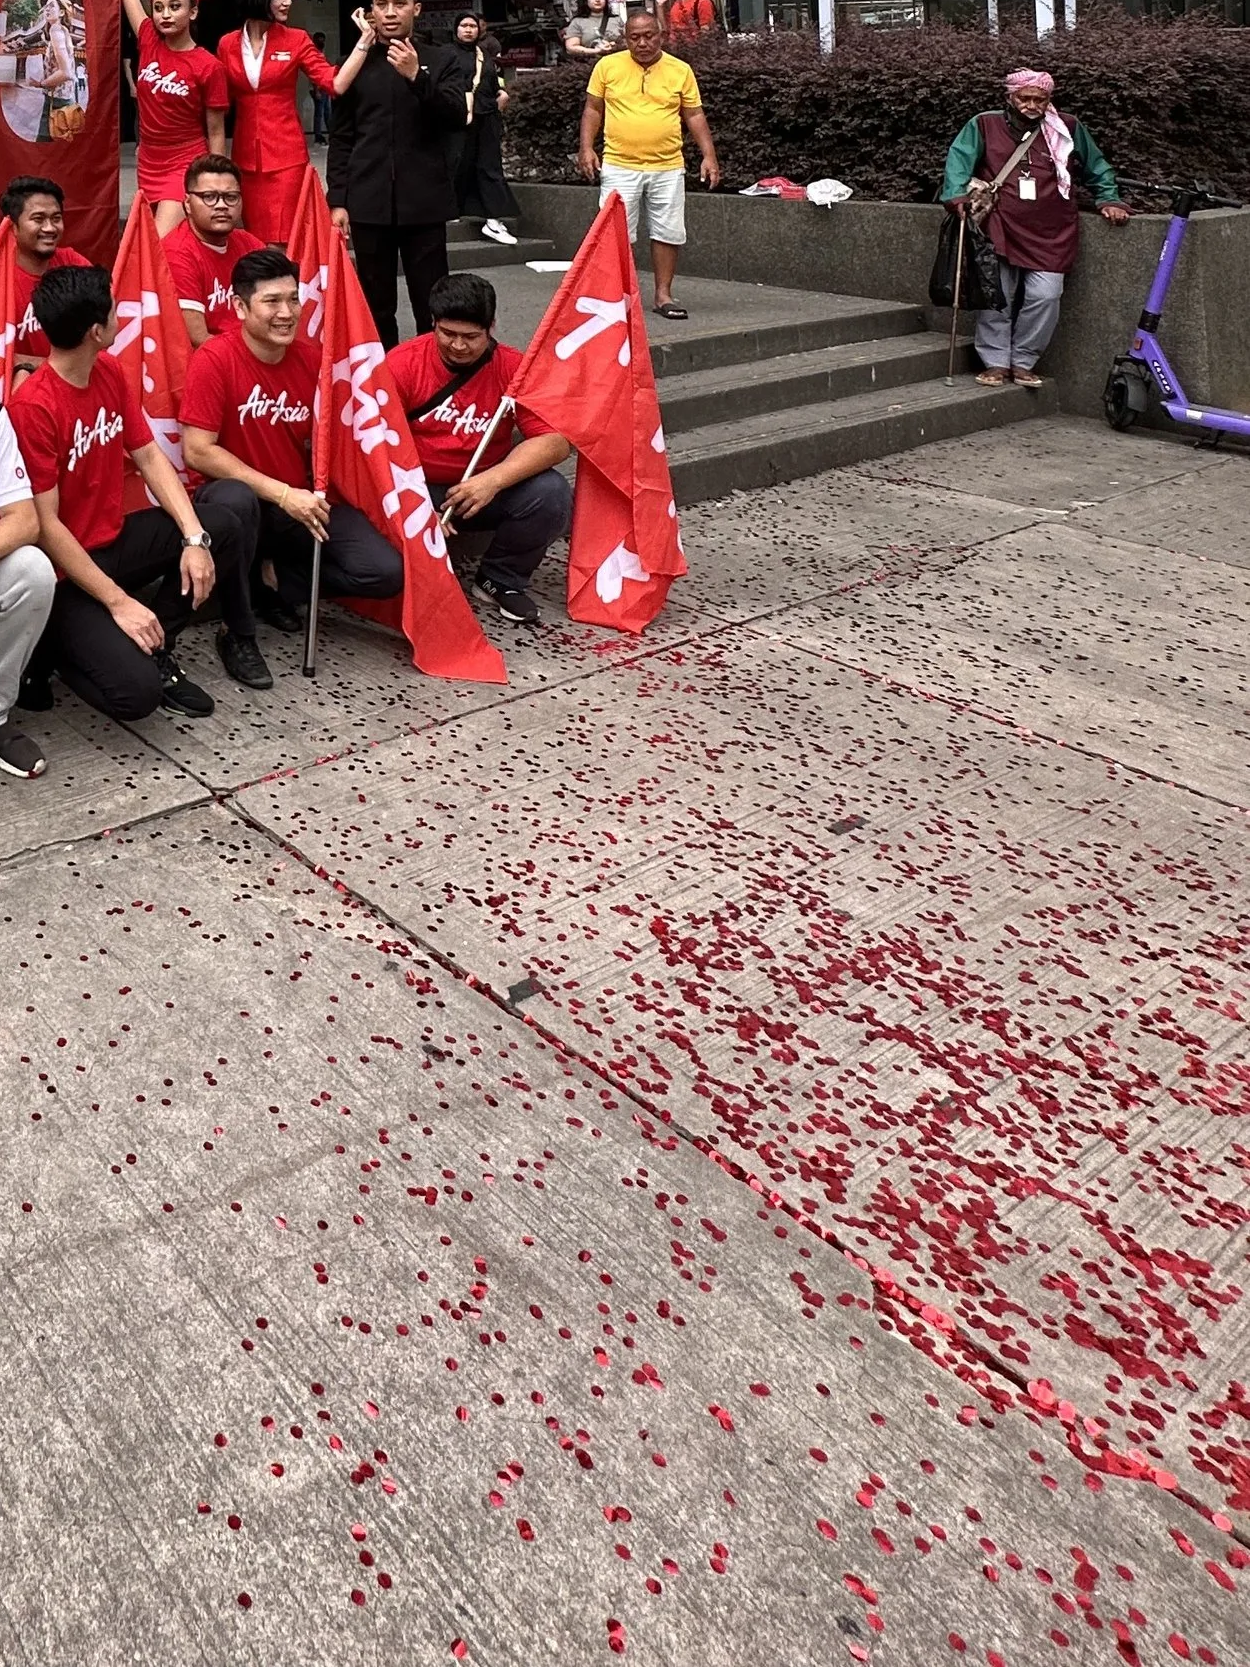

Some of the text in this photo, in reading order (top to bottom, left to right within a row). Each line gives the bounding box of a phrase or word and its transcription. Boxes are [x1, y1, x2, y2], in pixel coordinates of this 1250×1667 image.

[138, 61, 190, 96] AirAsia
[238, 384, 310, 425] AirAsia
[68, 407, 124, 472] AirAia
